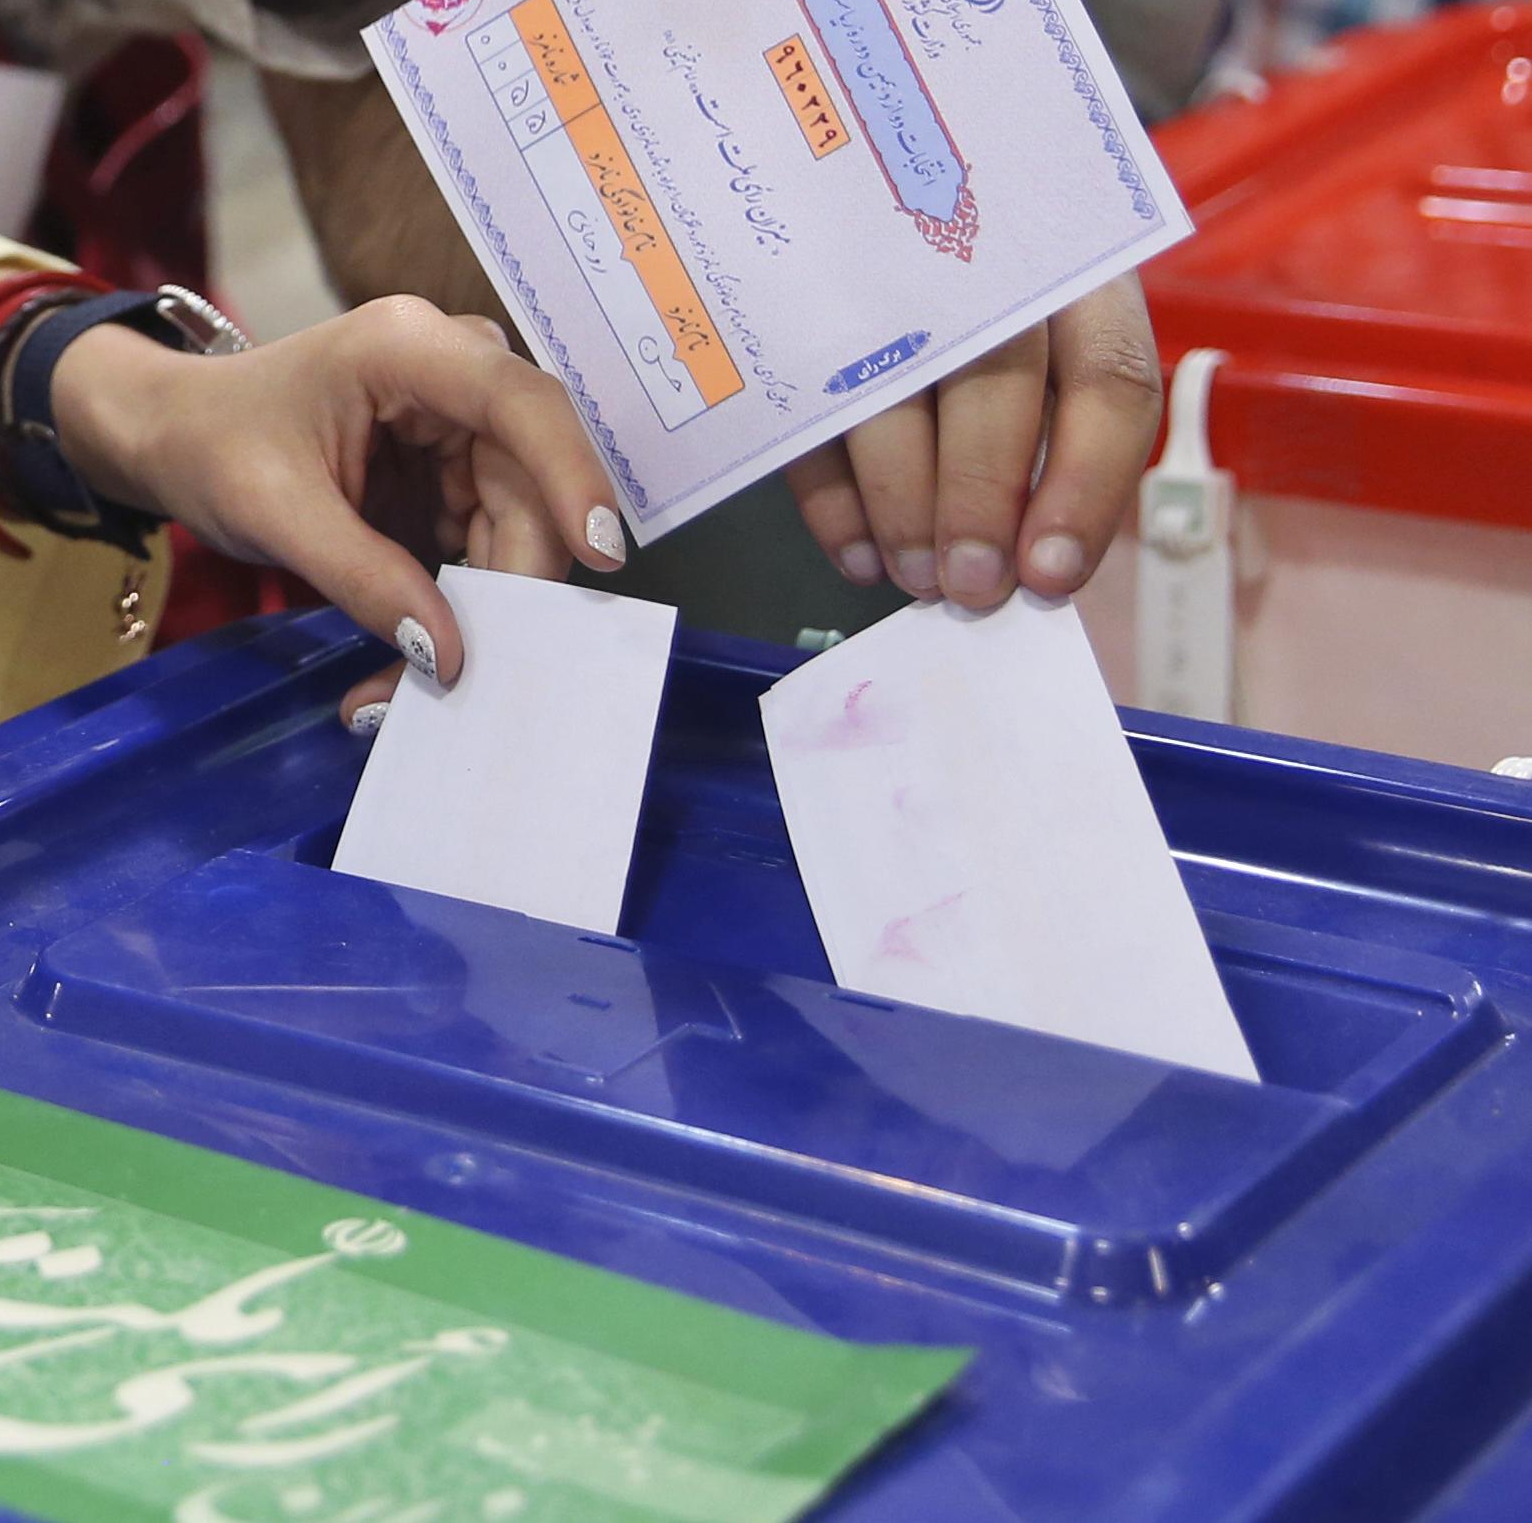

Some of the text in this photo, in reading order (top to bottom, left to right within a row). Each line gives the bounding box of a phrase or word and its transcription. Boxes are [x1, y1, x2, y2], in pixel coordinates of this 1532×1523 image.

[910, 15, 946, 60] وزارت
[950, 17, 983, 52] جمهوری
[528, 32, 581, 86] شماره نامزد
[775, 44, 839, 149] ۹۶۰۲۲۹
[855, 61, 906, 131] دوازدهمین
[716, 138, 757, 177] ملت
[895, 129, 947, 187] انتخابات
[585, 151, 658, 253] نام خانوادگی نامزد
[687, 229, 708, 250] مورد
[704, 270, 742, 308] خانوادگی
[665, 305, 711, 353] نام نامزد
[724, 306, 748, 324] نام
[737, 326, 758, 344] نام
[856, 348, 903, 381] برگ رأی
